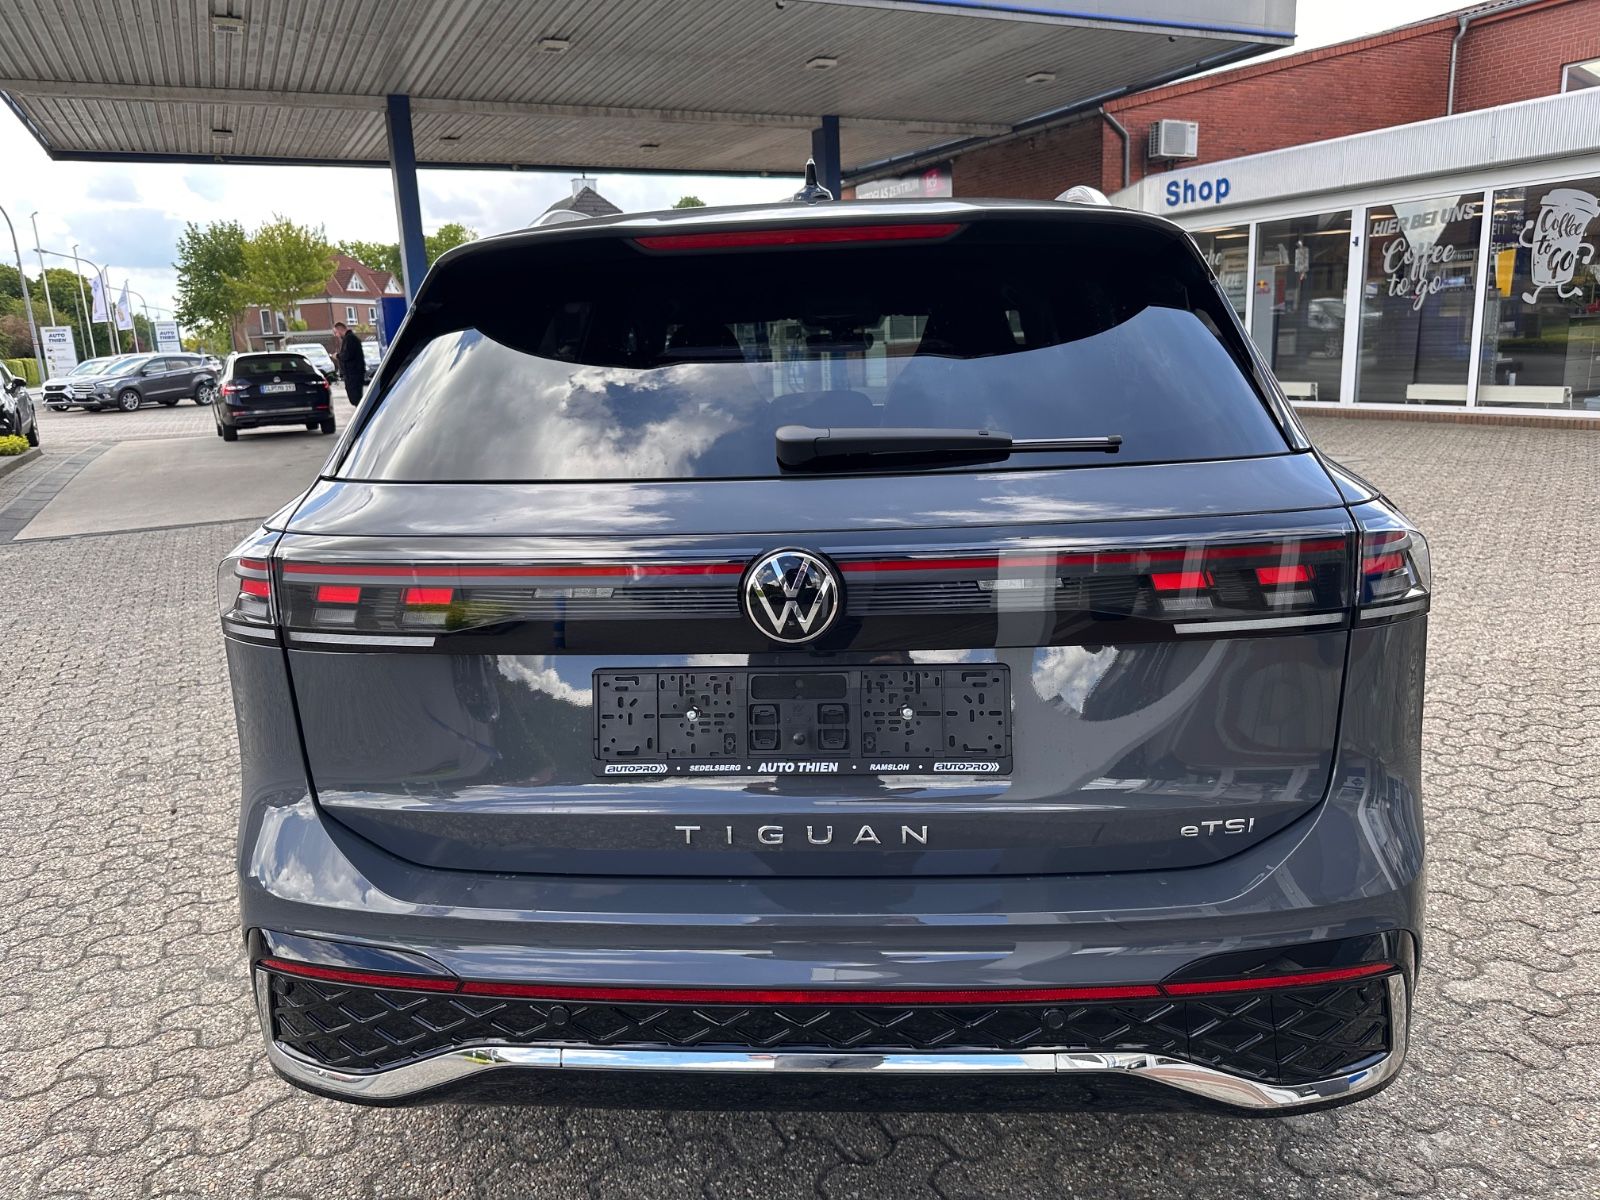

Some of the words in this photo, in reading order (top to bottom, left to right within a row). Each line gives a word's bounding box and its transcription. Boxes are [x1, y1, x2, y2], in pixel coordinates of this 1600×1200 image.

[1166, 178, 1230, 206] Shop
[1373, 217, 1409, 235] HIER
[1410, 211, 1439, 230] BEI
[1441, 203, 1476, 224] UNS
[1541, 209, 1583, 238] Coffee
[1535, 235, 1552, 255] to
[1383, 238, 1455, 281] Coffee
[1387, 274, 1410, 296] to
[1413, 276, 1441, 311] go
[750, 556, 833, 637] VW
[689, 764, 741, 772] SEDELSBERG
[758, 762, 794, 773] AUTO
[798, 762, 838, 772] THIEN
[869, 763, 909, 771] RAMSLOH
[675, 825, 928, 844] TIGUAN
[1180, 818, 1254, 837] eTSI
